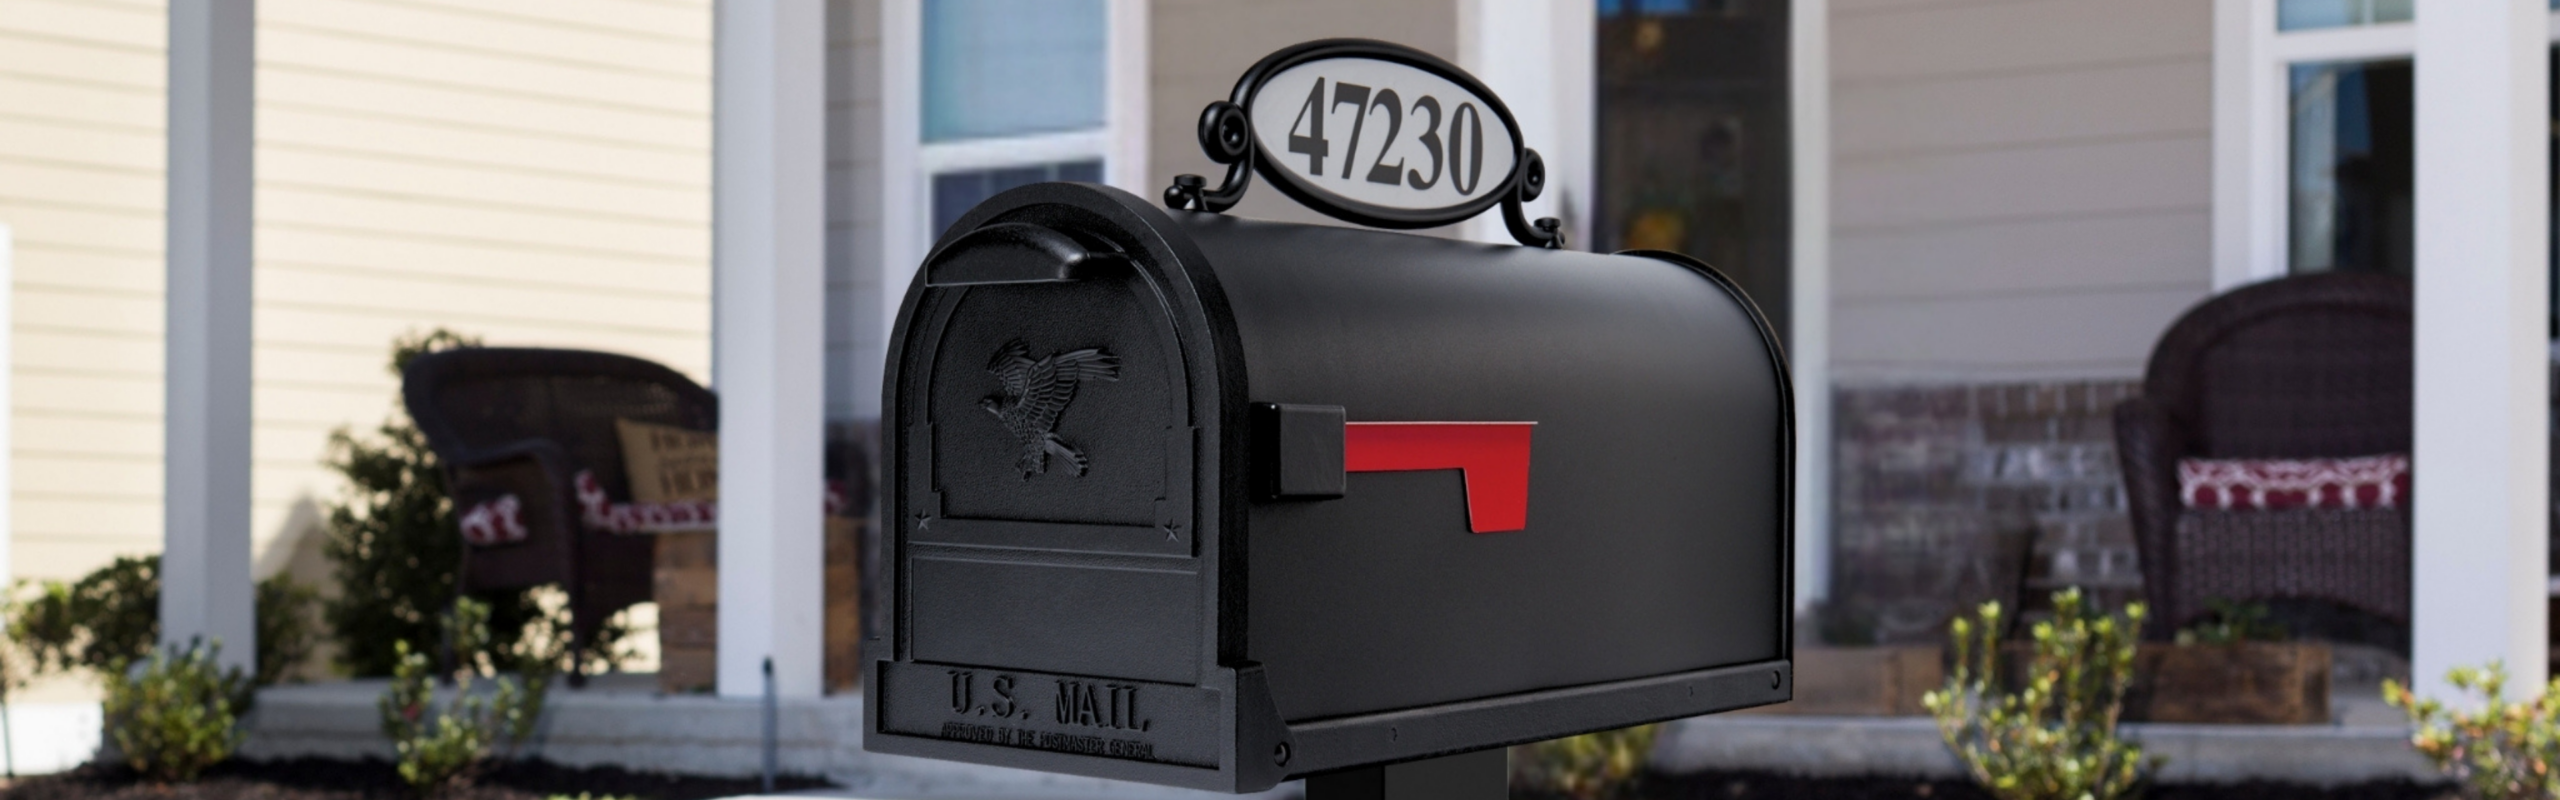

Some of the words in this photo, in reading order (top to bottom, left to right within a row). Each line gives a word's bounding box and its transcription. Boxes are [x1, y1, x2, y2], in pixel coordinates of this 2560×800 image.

[1288, 76, 1483, 196] 47230
[948, 671, 1030, 719] U.S.
[1055, 680, 1150, 732] MAIL
[940, 723, 994, 743] APPROVED
[997, 727, 1013, 746] BY
[1016, 728, 1037, 747] THE
[1039, 732, 1106, 756] POSTMASTER
[1108, 738, 1157, 760] GENERAL
